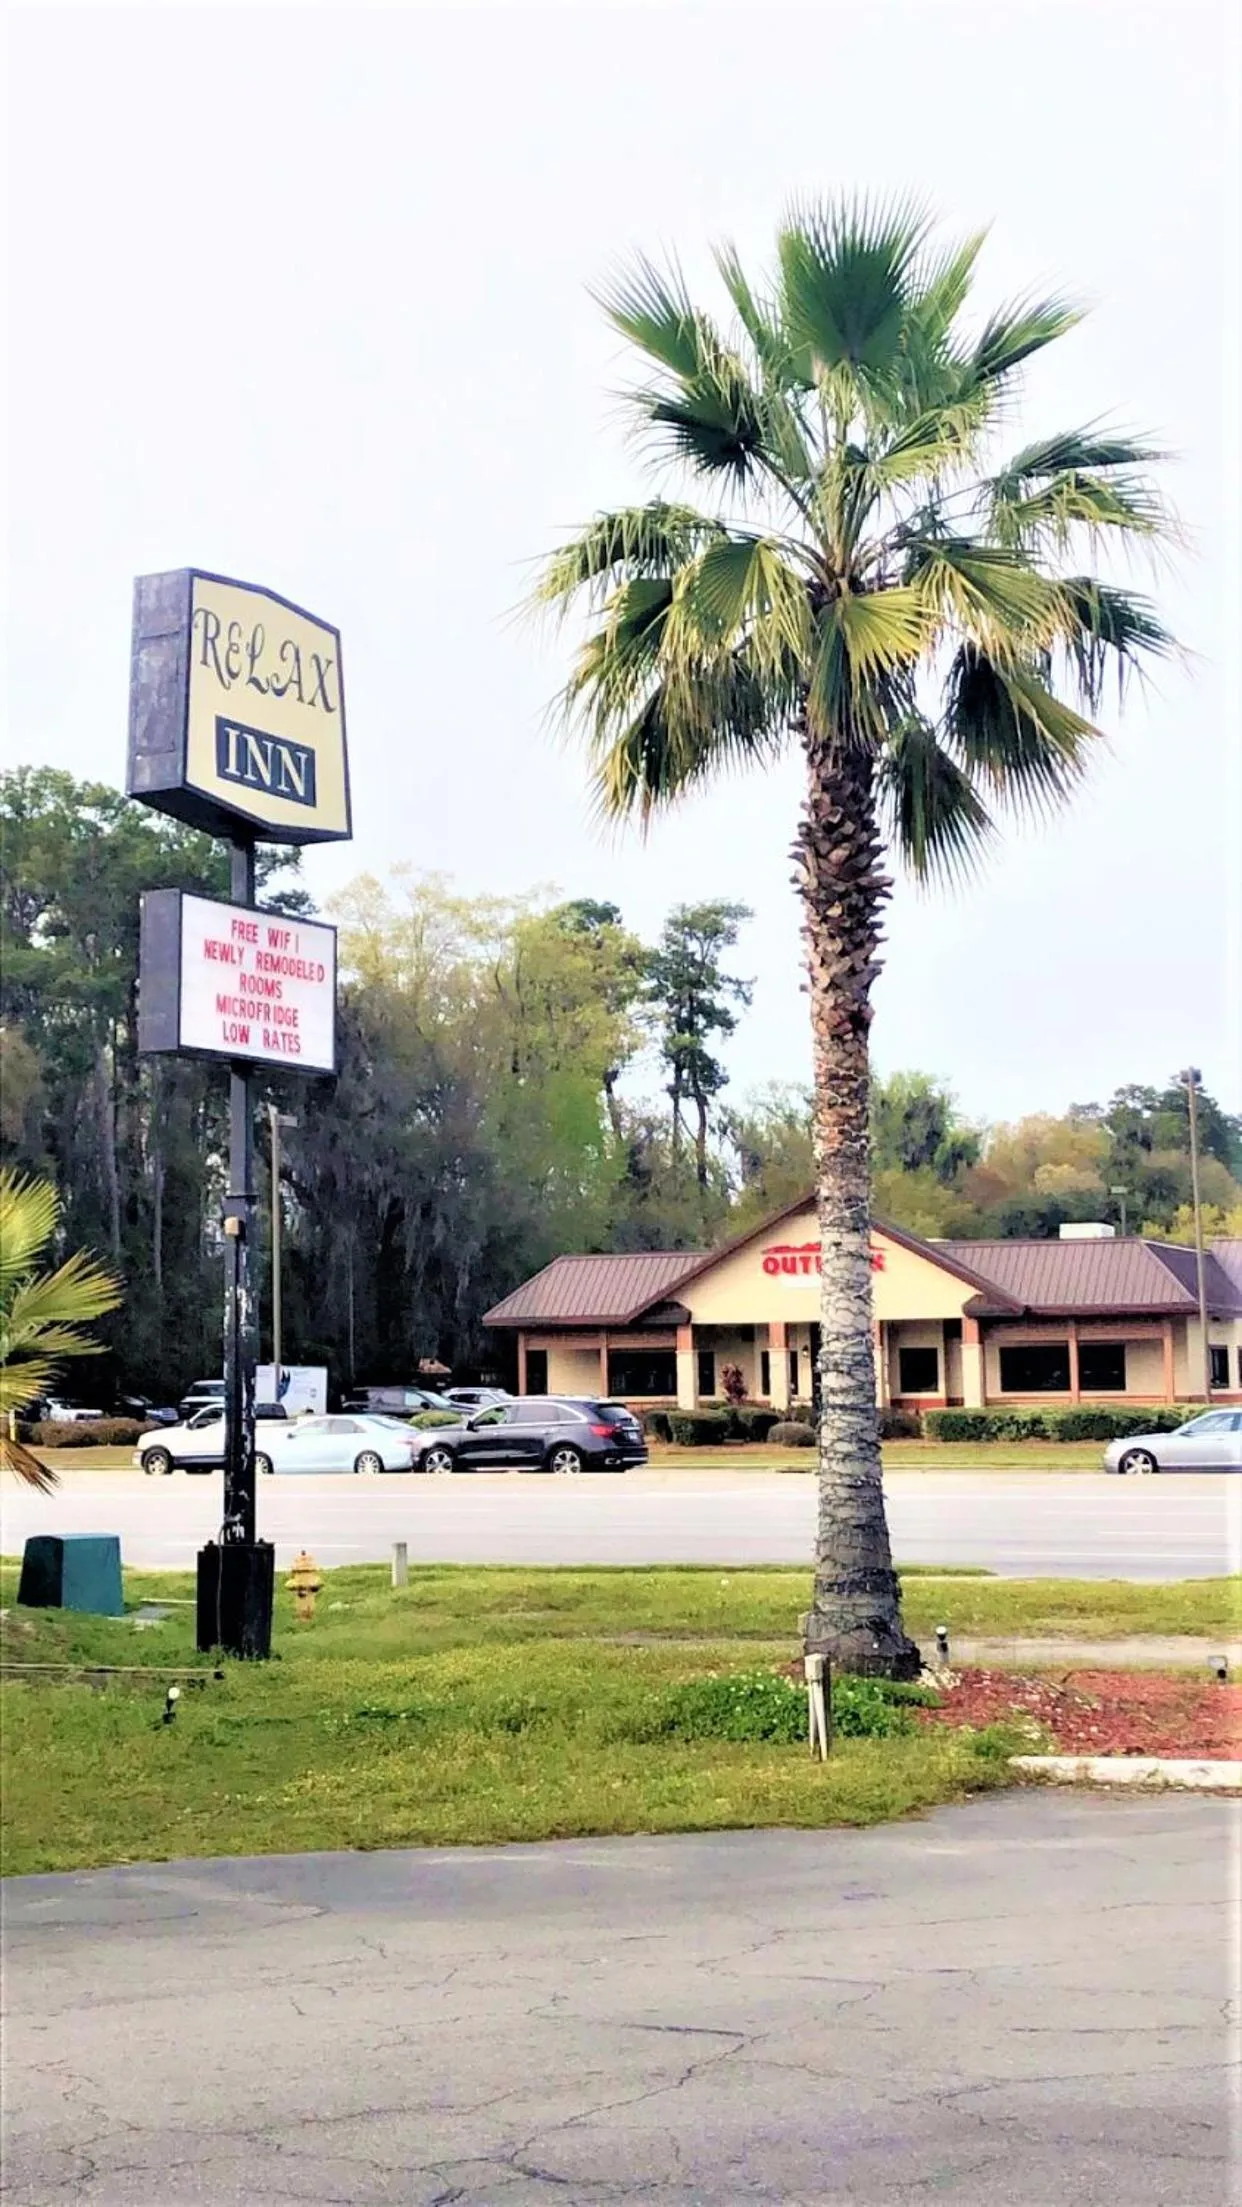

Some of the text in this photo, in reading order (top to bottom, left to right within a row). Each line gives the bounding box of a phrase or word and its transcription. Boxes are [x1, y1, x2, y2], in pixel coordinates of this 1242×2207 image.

[194, 607, 336, 713] RELAX
[224, 727, 307, 797] INN
[231, 919, 259, 944] FREE
[204, 939, 325, 982] NEWLY REMODELED
[240, 973, 283, 999] ROOMS
[216, 993, 299, 1027] MICROFRIDGE
[223, 1020, 301, 1053] LOW RATES
